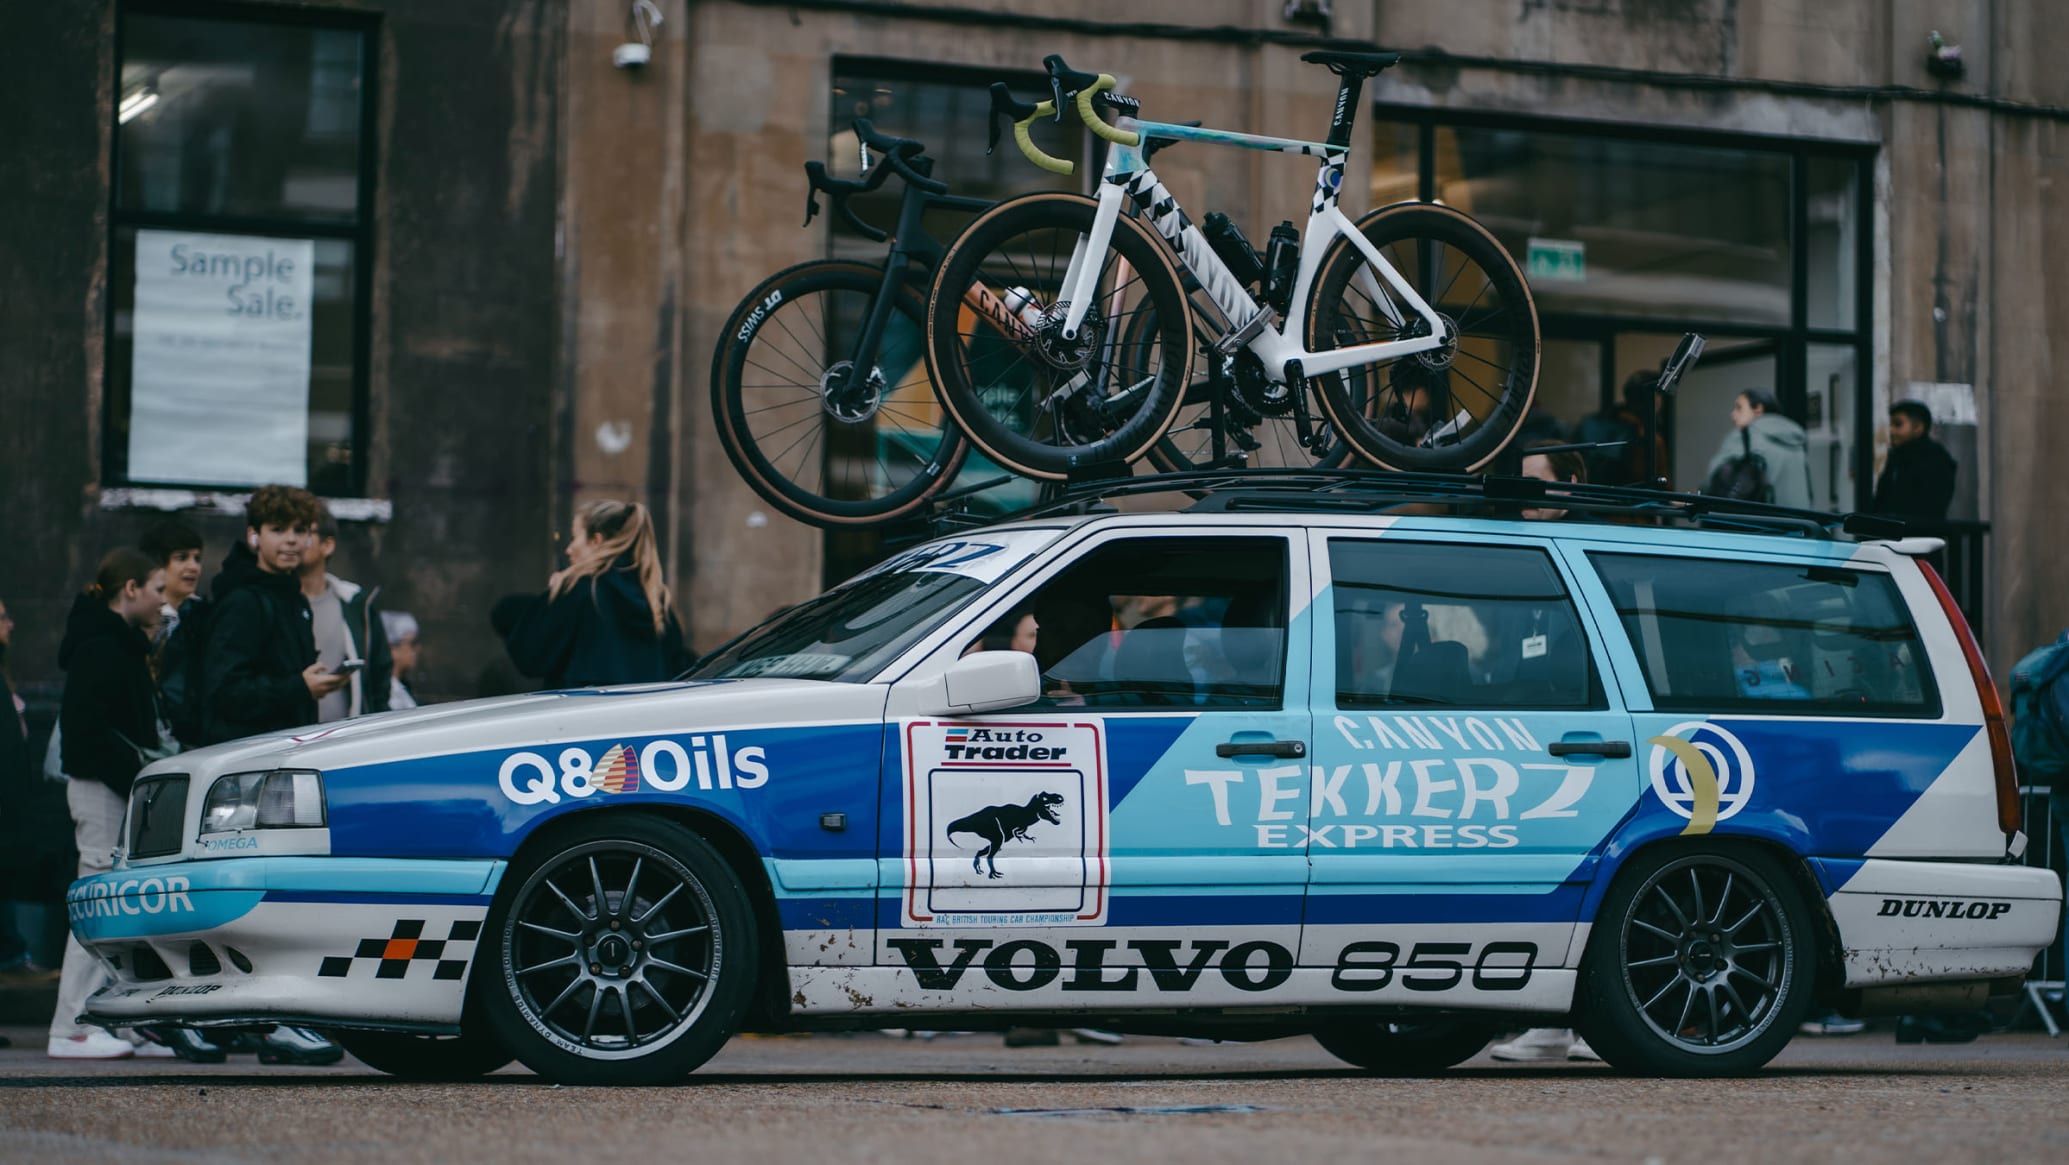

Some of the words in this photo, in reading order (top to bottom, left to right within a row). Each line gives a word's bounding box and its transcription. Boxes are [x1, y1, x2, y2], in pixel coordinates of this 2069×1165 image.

[1104, 91, 1140, 107] CANYON
[170, 243, 295, 284] Sample
[225, 283, 303, 320] Sale.
[737, 305, 765, 343] SWISS
[968, 728, 1044, 743] Auto
[1334, 715, 1543, 752] CANYON
[944, 744, 1067, 761] Trader
[498, 747, 598, 806] Q8
[640, 734, 769, 792] Oils
[208, 836, 258, 851] OMEGA
[1252, 824, 1519, 849] EXPRESS
[952, 914, 978, 924] BRITISH
[980, 914, 1008, 923] TOURING
[1010, 914, 1024, 923] CAR
[1025, 913, 1075, 923] CHAMPIONSHIP
[1876, 899, 2012, 920] DUNLOP
[886, 938, 1295, 992] VOLVO
[1331, 941, 1539, 992] 850
